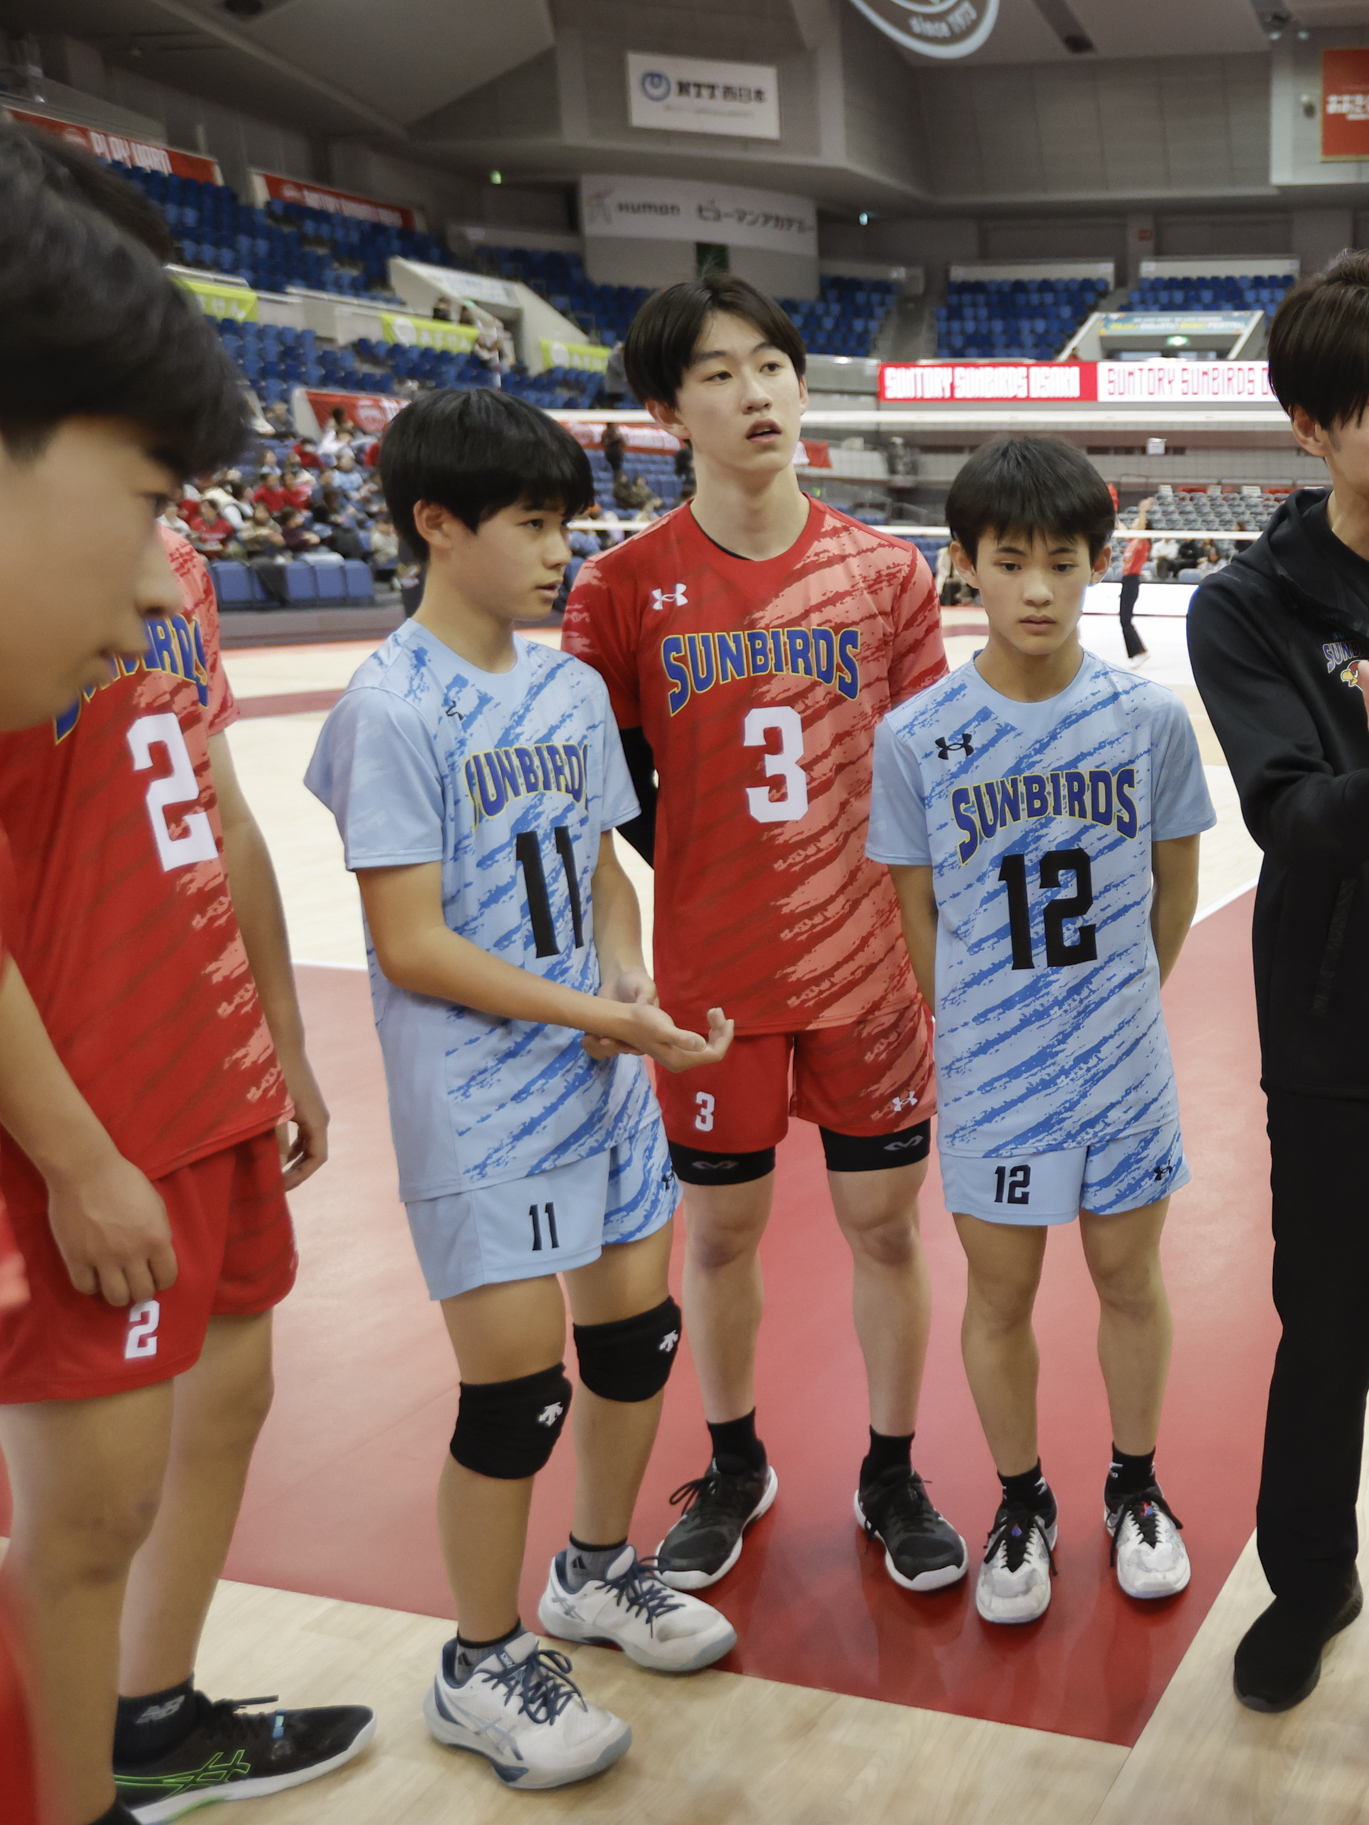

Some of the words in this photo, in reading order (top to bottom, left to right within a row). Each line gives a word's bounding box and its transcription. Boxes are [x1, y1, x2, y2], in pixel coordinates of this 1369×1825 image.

[884, 366, 953, 398] SUNTORY
[953, 366, 1028, 398] SUNBIRDS
[1028, 366, 1080, 398] OSAKA
[1107, 367, 1175, 396] SUNTORY
[1181, 367, 1256, 396] SUNBIRDS
[661, 626, 860, 717] SUNBIRDS
[127, 712, 219, 872] 2
[743, 705, 809, 823] 3
[951, 767, 1138, 866] SUNBIRDS
[516, 826, 584, 958] 11
[998, 848, 1098, 970] 12
[695, 1091, 716, 1132] 3
[994, 1164, 1031, 1205] 12
[528, 1202, 560, 1251] 11
[124, 1299, 160, 1360] 2
